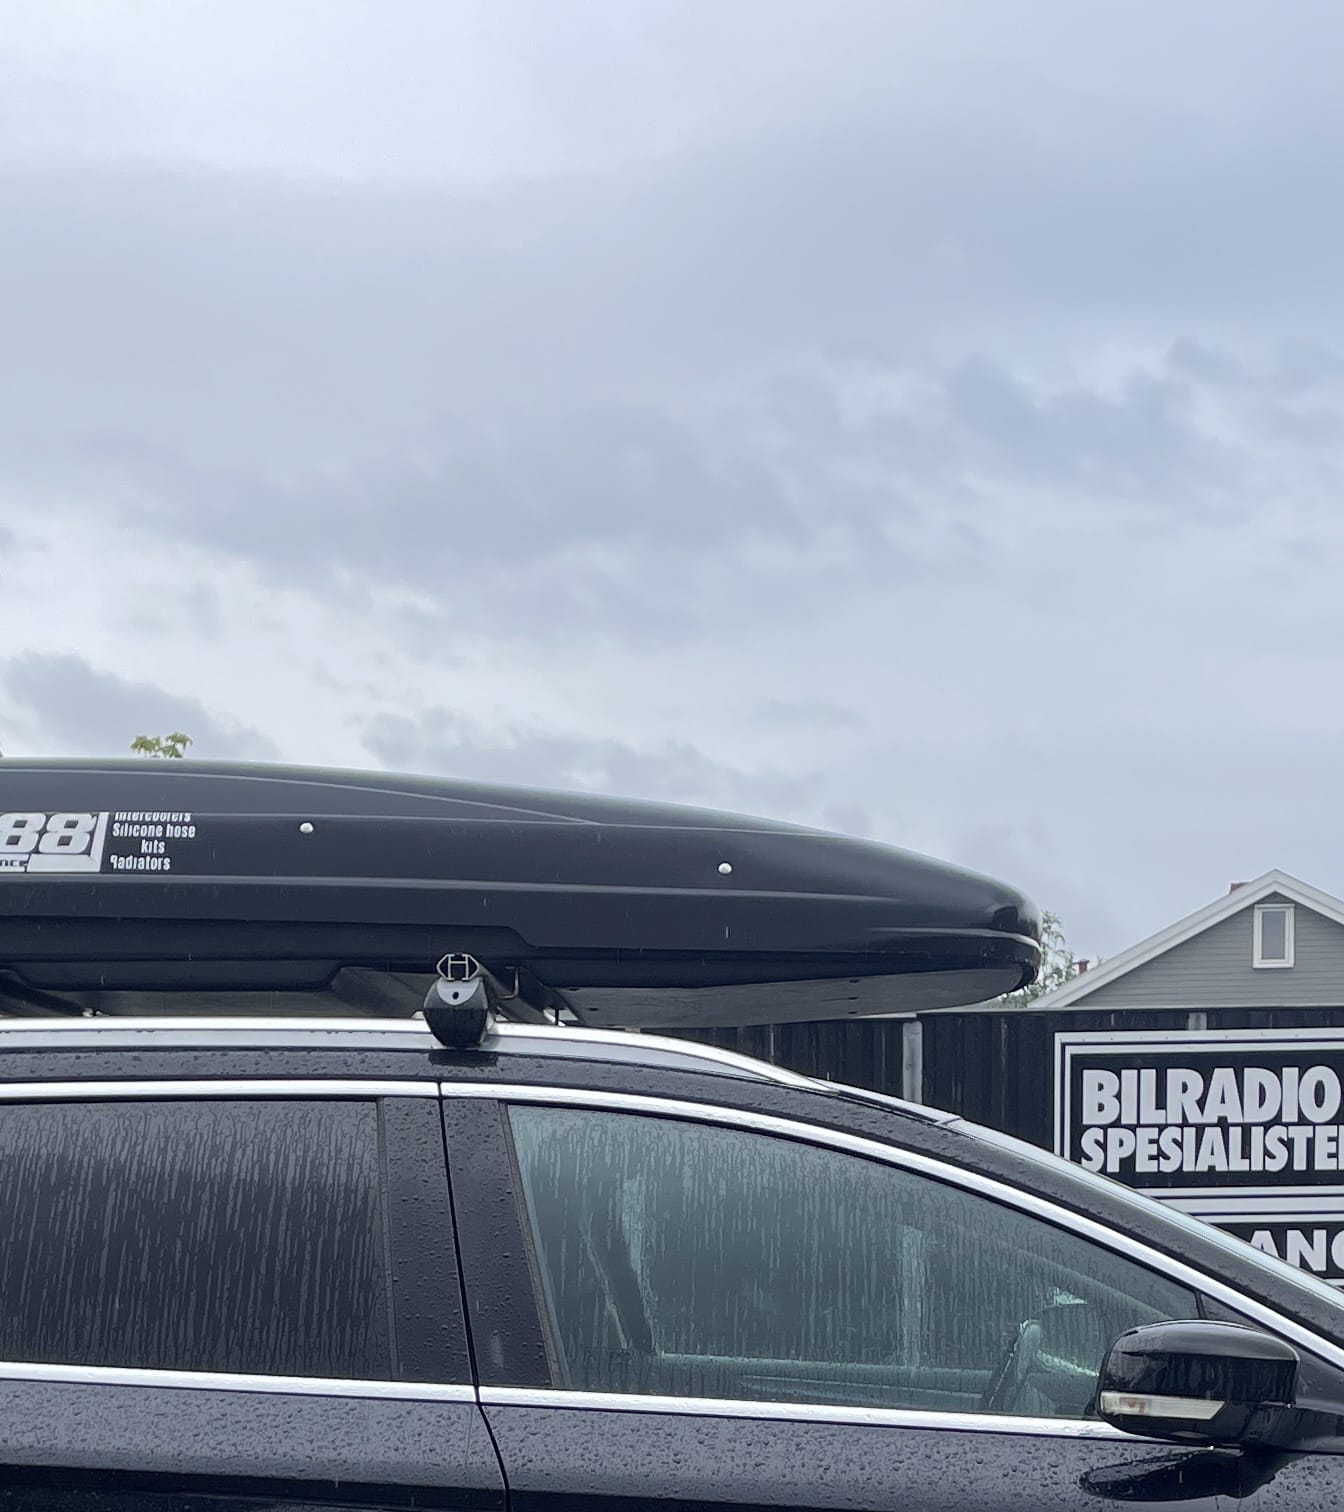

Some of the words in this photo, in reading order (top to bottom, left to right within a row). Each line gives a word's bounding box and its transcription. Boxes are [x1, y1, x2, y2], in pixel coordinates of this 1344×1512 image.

[112, 822, 164, 838] Silicone
[165, 823, 197, 839] hose
[140, 838, 166, 854] kits
